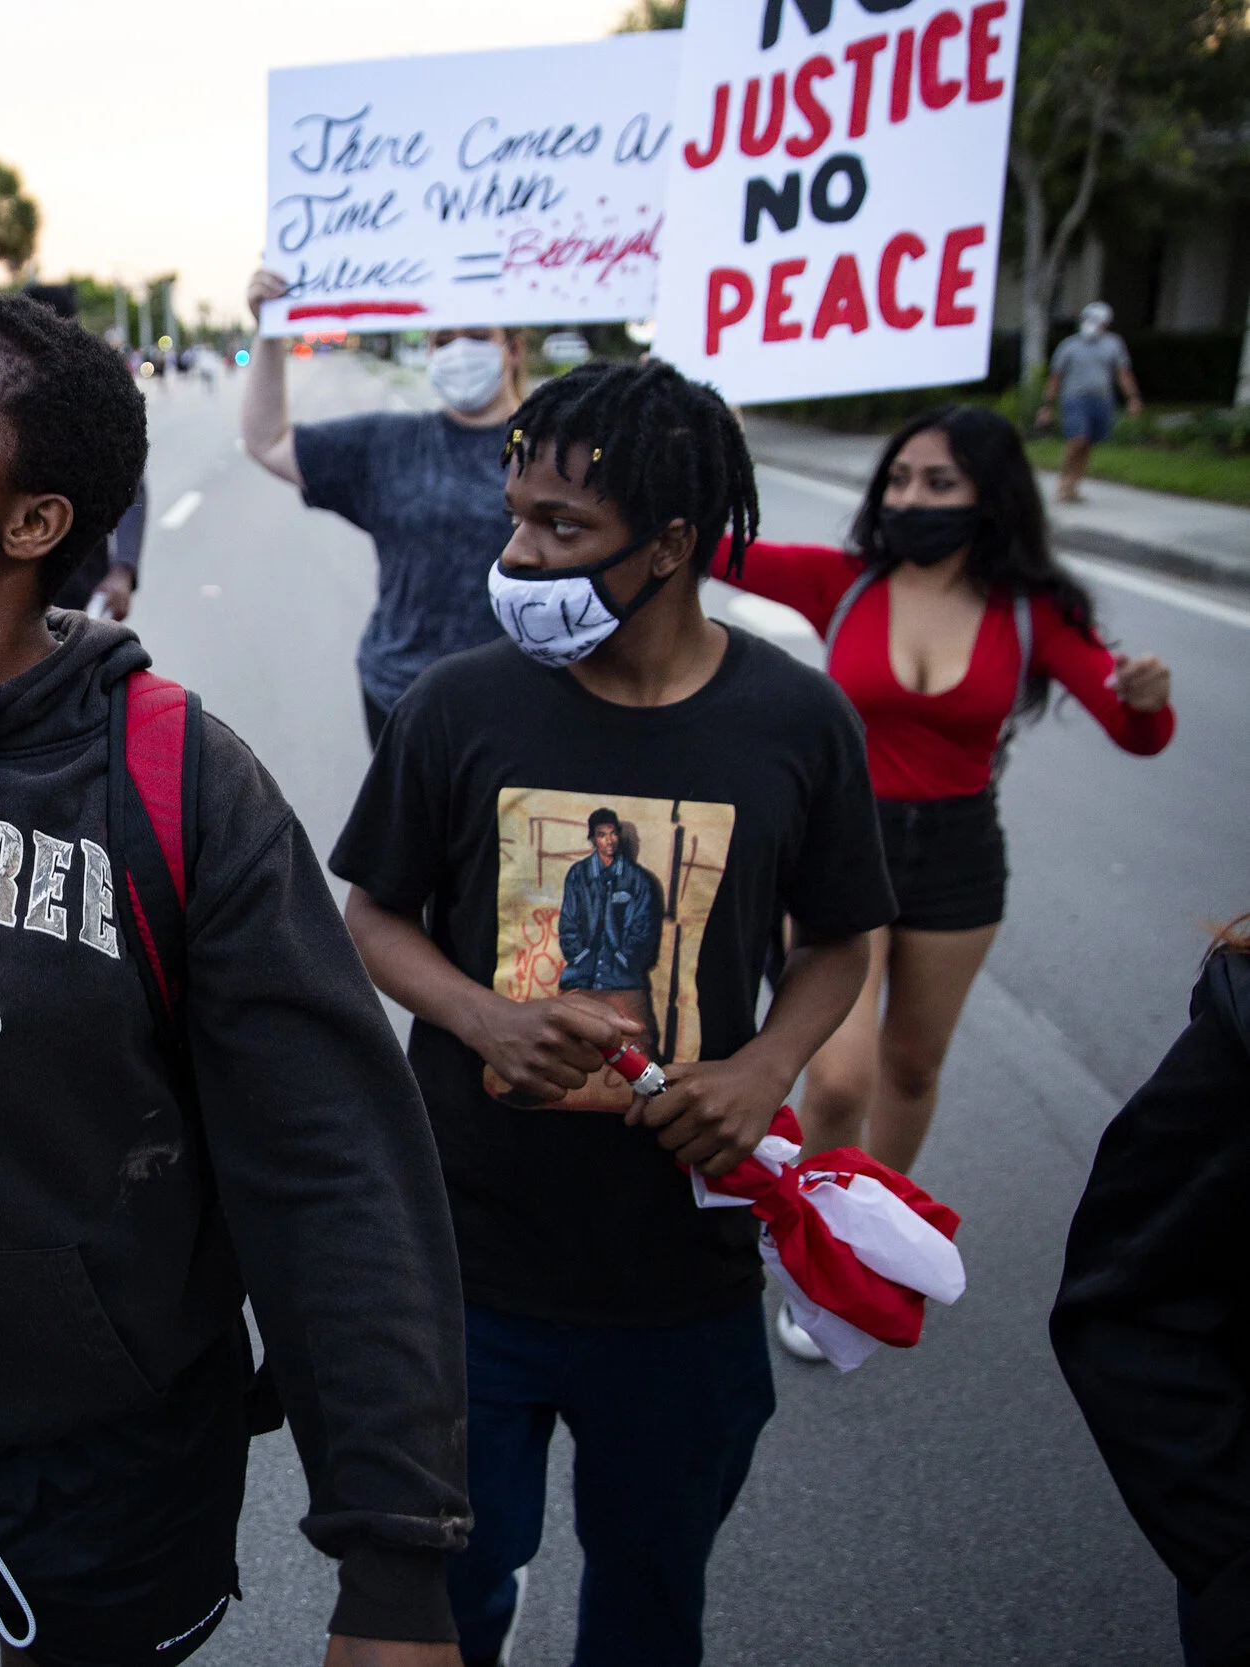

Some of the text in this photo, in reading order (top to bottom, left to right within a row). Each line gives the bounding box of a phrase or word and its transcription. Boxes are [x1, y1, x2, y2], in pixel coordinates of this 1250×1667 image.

[684, 0, 1007, 170] JUSTICE
[291, 102, 431, 175] There
[459, 117, 603, 171] Comes
[273, 172, 568, 253] Time When
[742, 151, 868, 244] NO
[704, 224, 986, 356] PEACE
[496, 592, 617, 646] UCK
